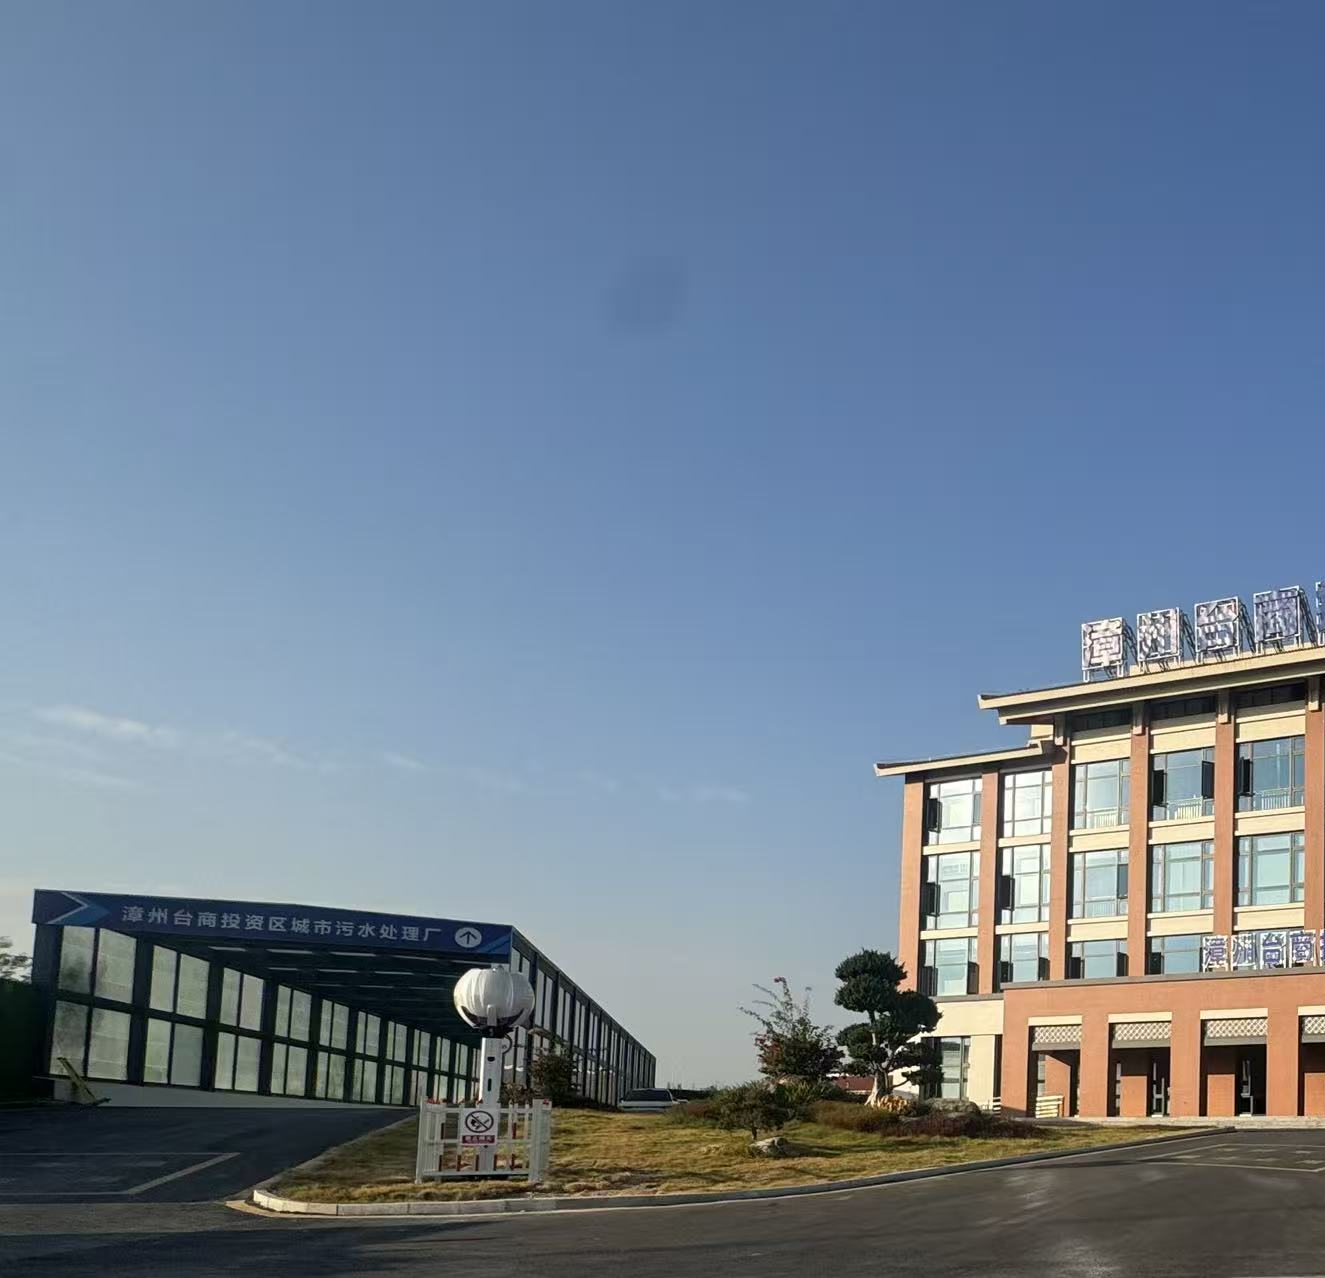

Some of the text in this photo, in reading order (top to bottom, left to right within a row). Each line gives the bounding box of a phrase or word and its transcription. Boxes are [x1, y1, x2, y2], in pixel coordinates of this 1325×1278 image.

[122, 905, 442, 942] 漳州台商投资区城市污水处理厂
